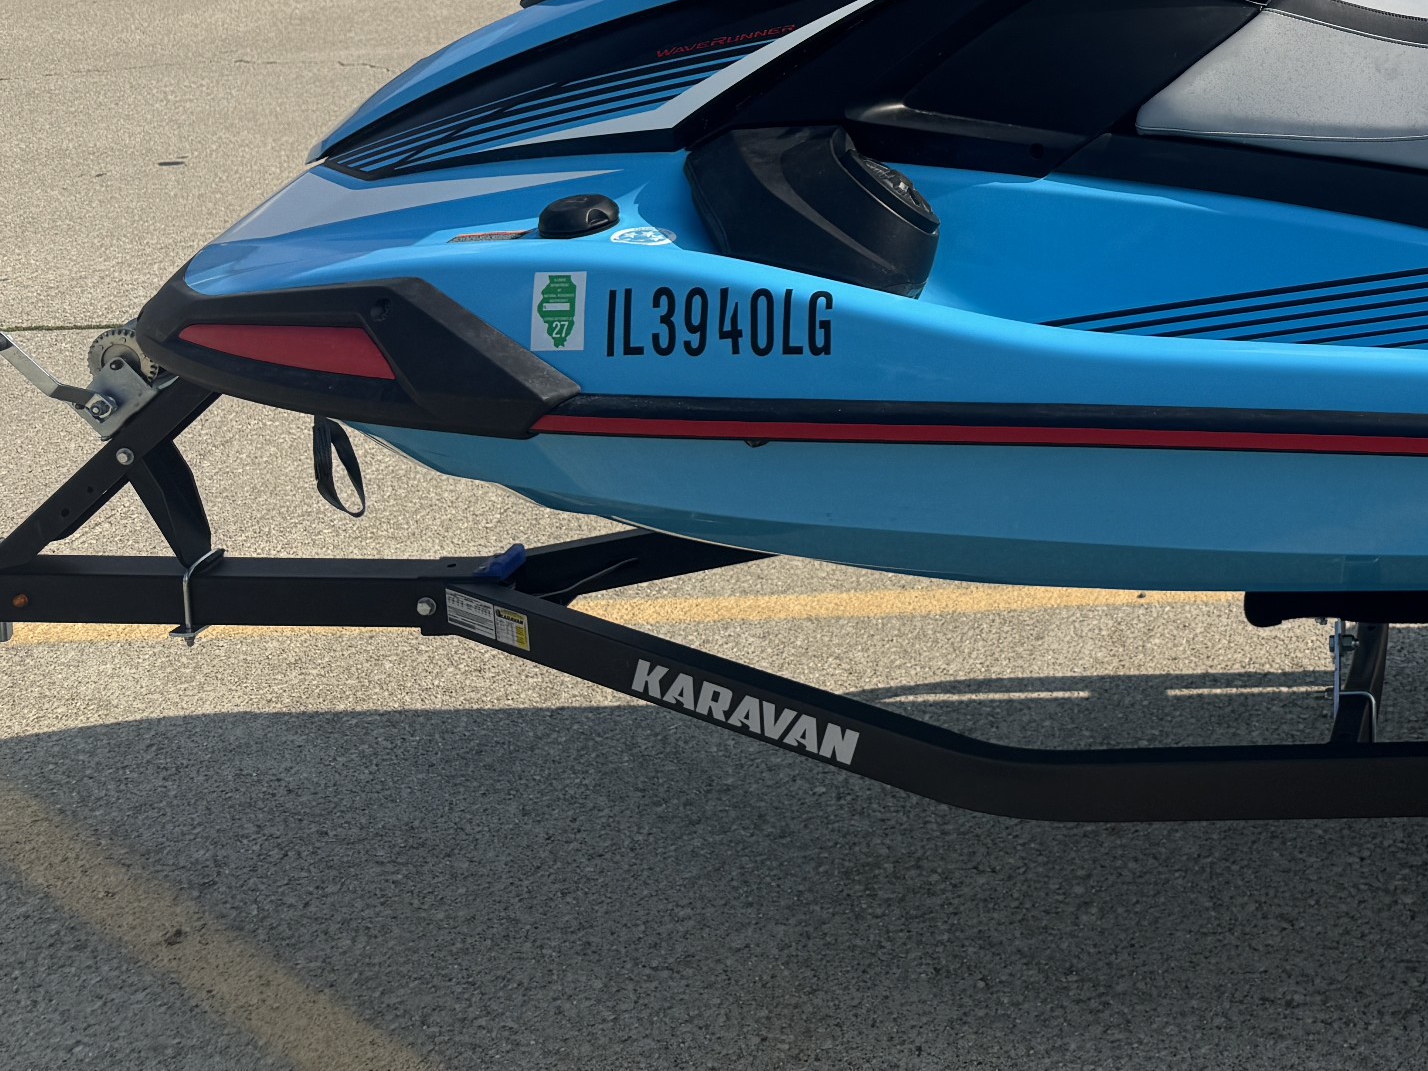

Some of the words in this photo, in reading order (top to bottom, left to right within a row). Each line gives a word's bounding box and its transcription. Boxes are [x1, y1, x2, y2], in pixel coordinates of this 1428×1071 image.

[656, 24, 796, 58] WAVERUNNER
[552, 321, 569, 338] 27
[606, 286, 834, 357] IL3940LG
[631, 658, 860, 766] KARAVAN
